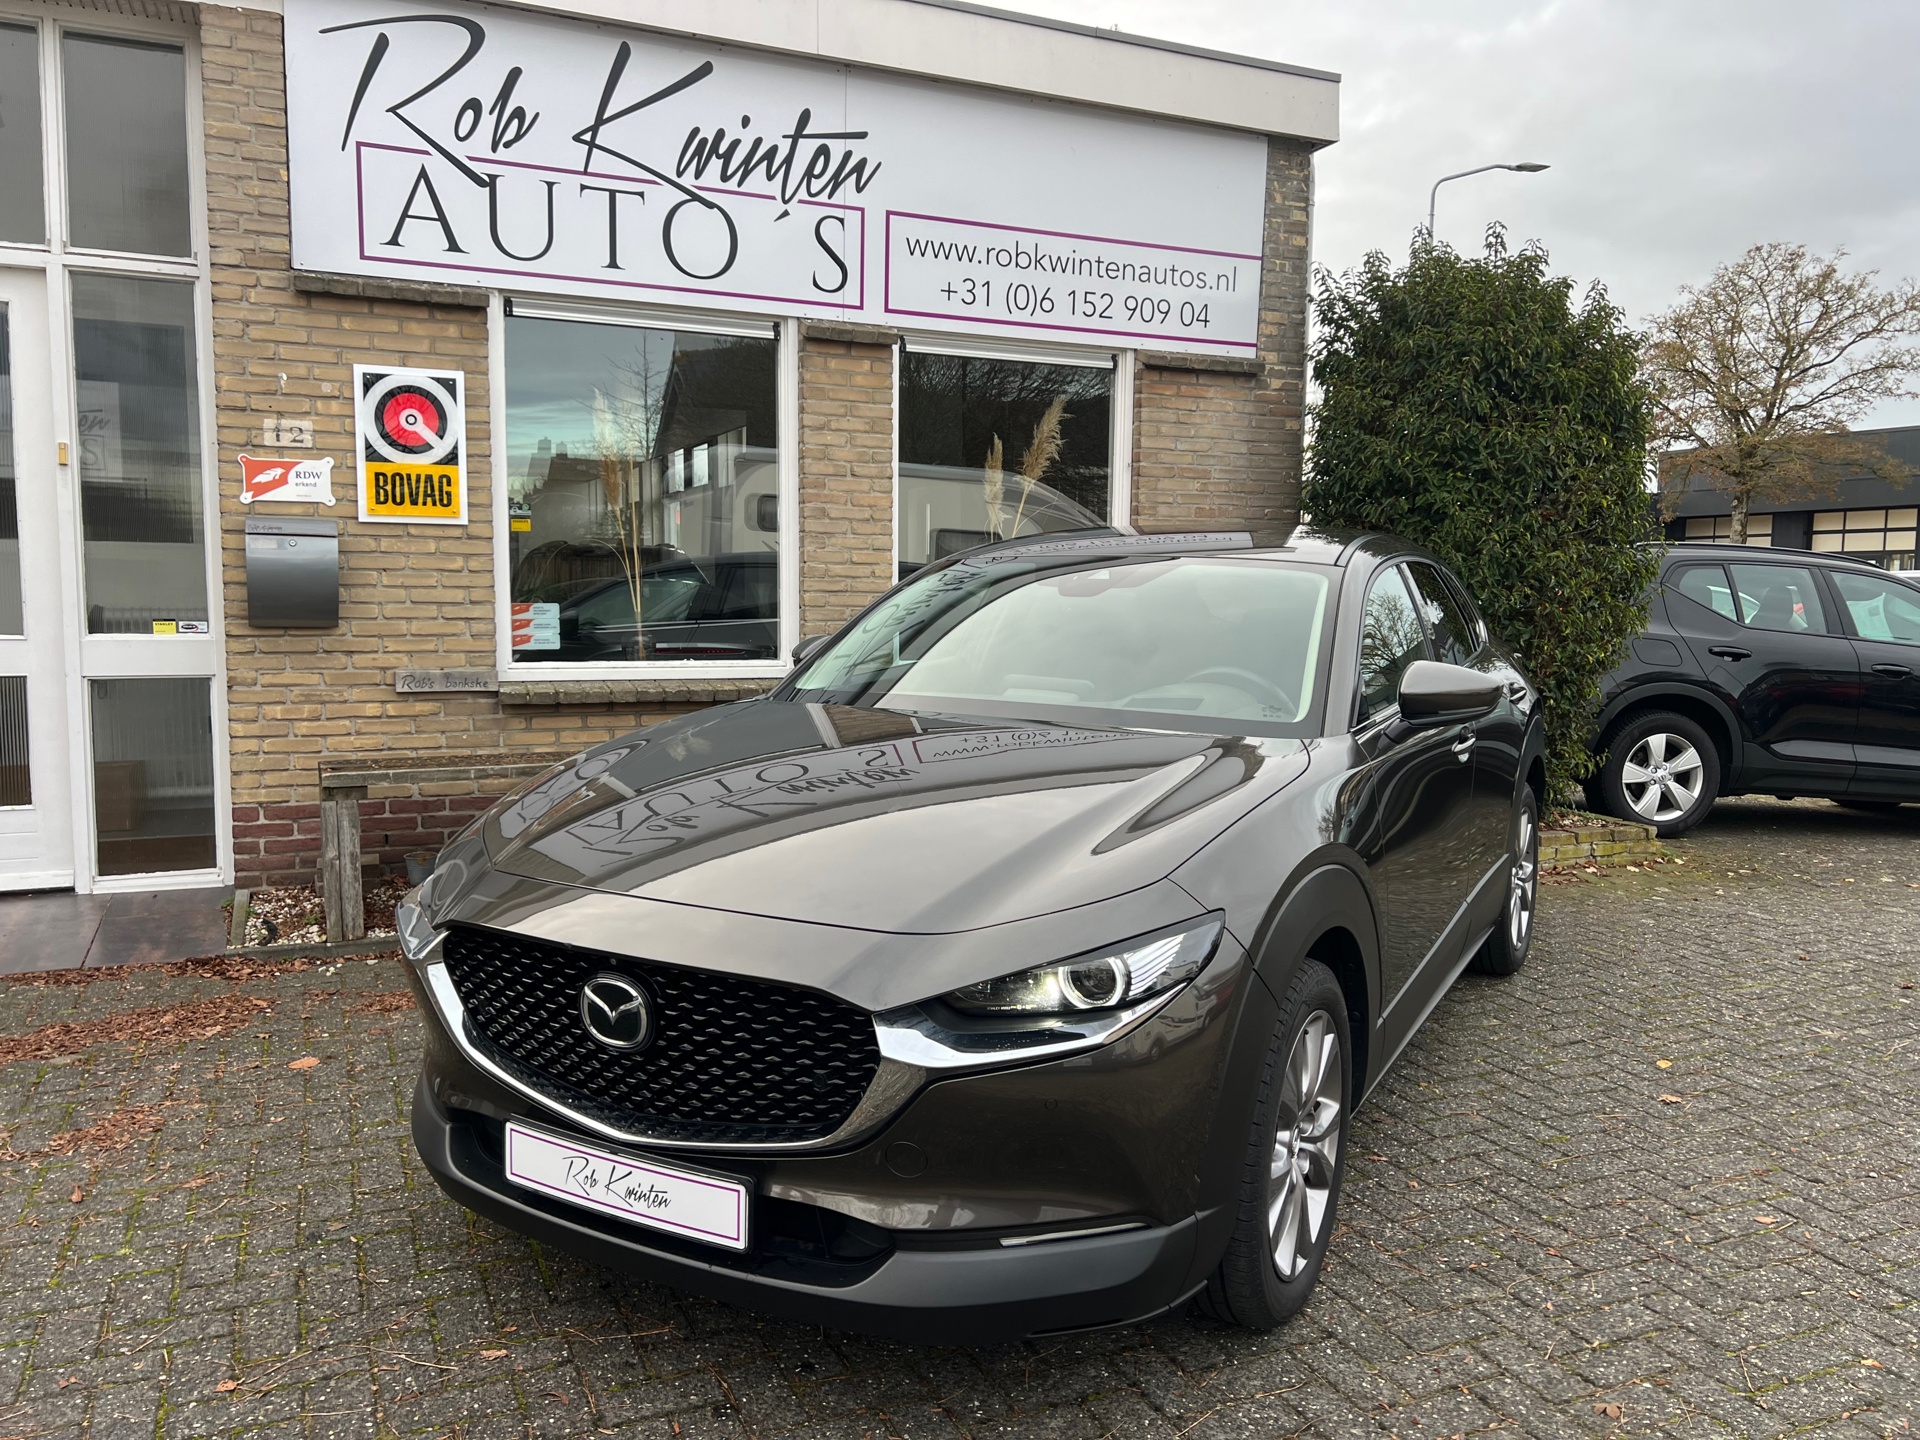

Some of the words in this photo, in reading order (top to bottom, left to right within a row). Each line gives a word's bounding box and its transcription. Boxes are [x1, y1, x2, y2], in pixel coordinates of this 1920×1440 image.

[319, 14, 540, 188] Rob
[571, 41, 882, 210] Kwinten
[905, 236, 1238, 292] www.robkwintenautos.nl
[940, 278, 990, 307] +31
[1006, 282, 1055, 316] (0)6
[1067, 290, 1113, 319] 152
[1124, 295, 1171, 324] 909
[1180, 301, 1210, 328] 04
[273, 426, 304, 443] 12
[295, 471, 322, 479] RDW
[374, 472, 452, 507] BOVAG
[401, 674, 435, 690] Rob's
[444, 676, 489, 688] bankske
[562, 1156, 599, 1196] Rob
[604, 1165, 671, 1208] Kwinten
